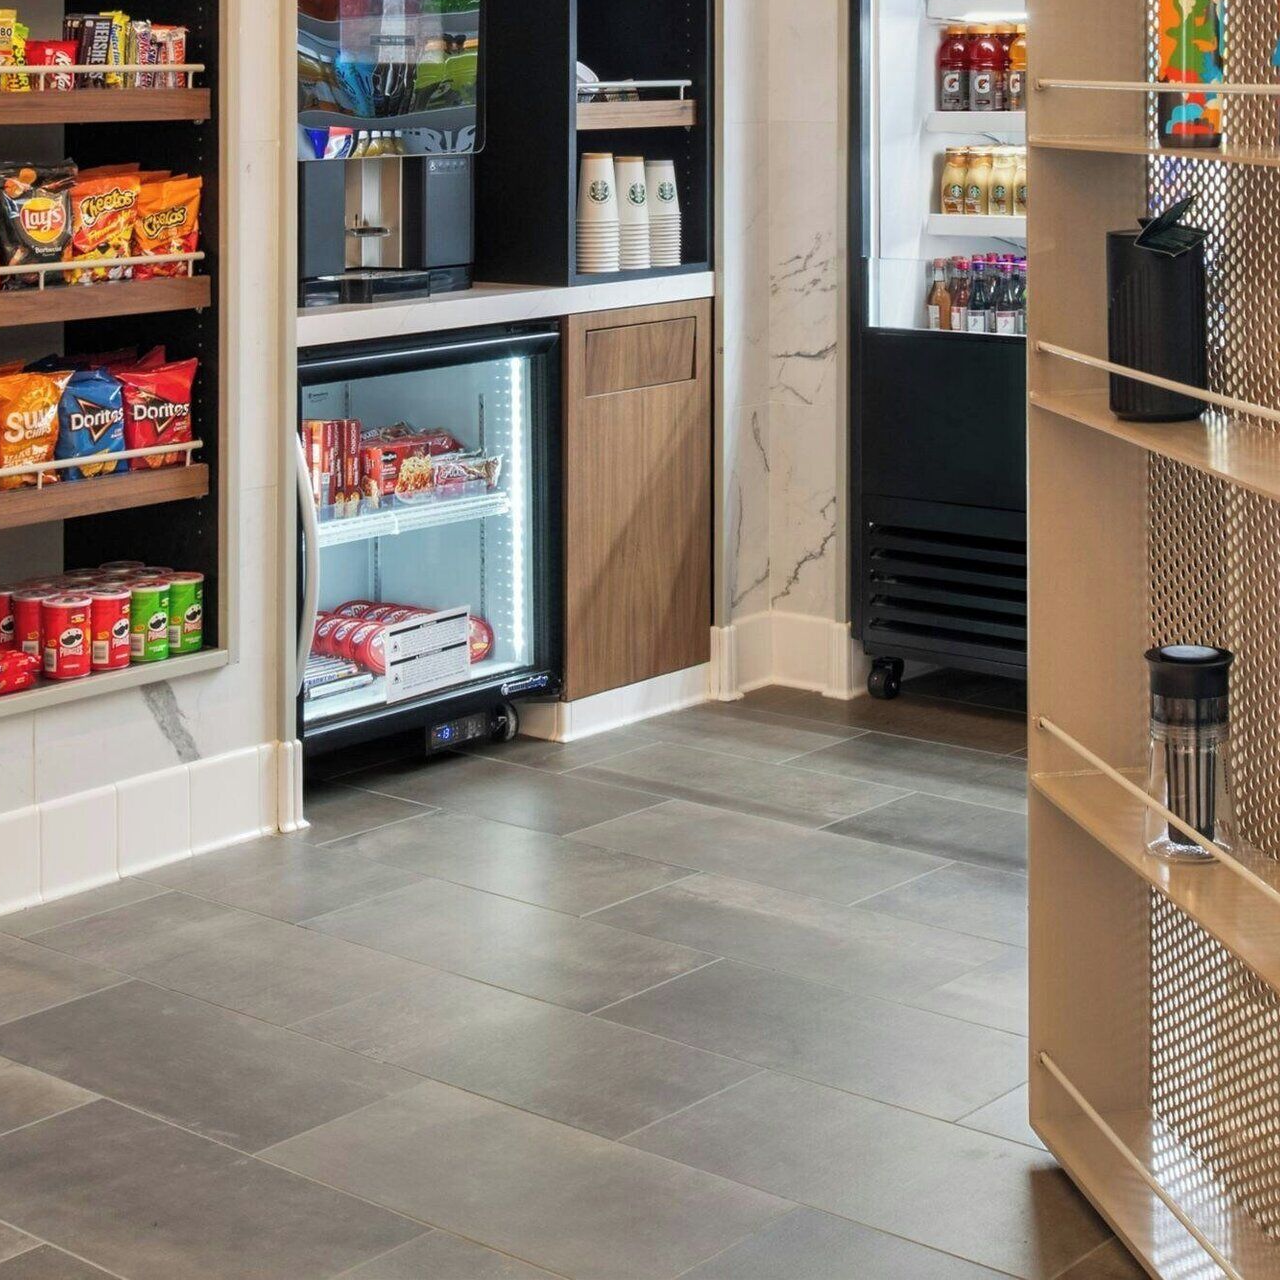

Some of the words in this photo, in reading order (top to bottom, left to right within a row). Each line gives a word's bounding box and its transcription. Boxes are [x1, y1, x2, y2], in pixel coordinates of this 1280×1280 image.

[81, 189, 134, 224] Cheetos
[26, 207, 62, 232] Lay's
[143, 207, 187, 237] Cheetos
[70, 408, 123, 431] Doritos
[133, 403, 190, 421] Doritos
[24, 426, 51, 439] CHIPS
